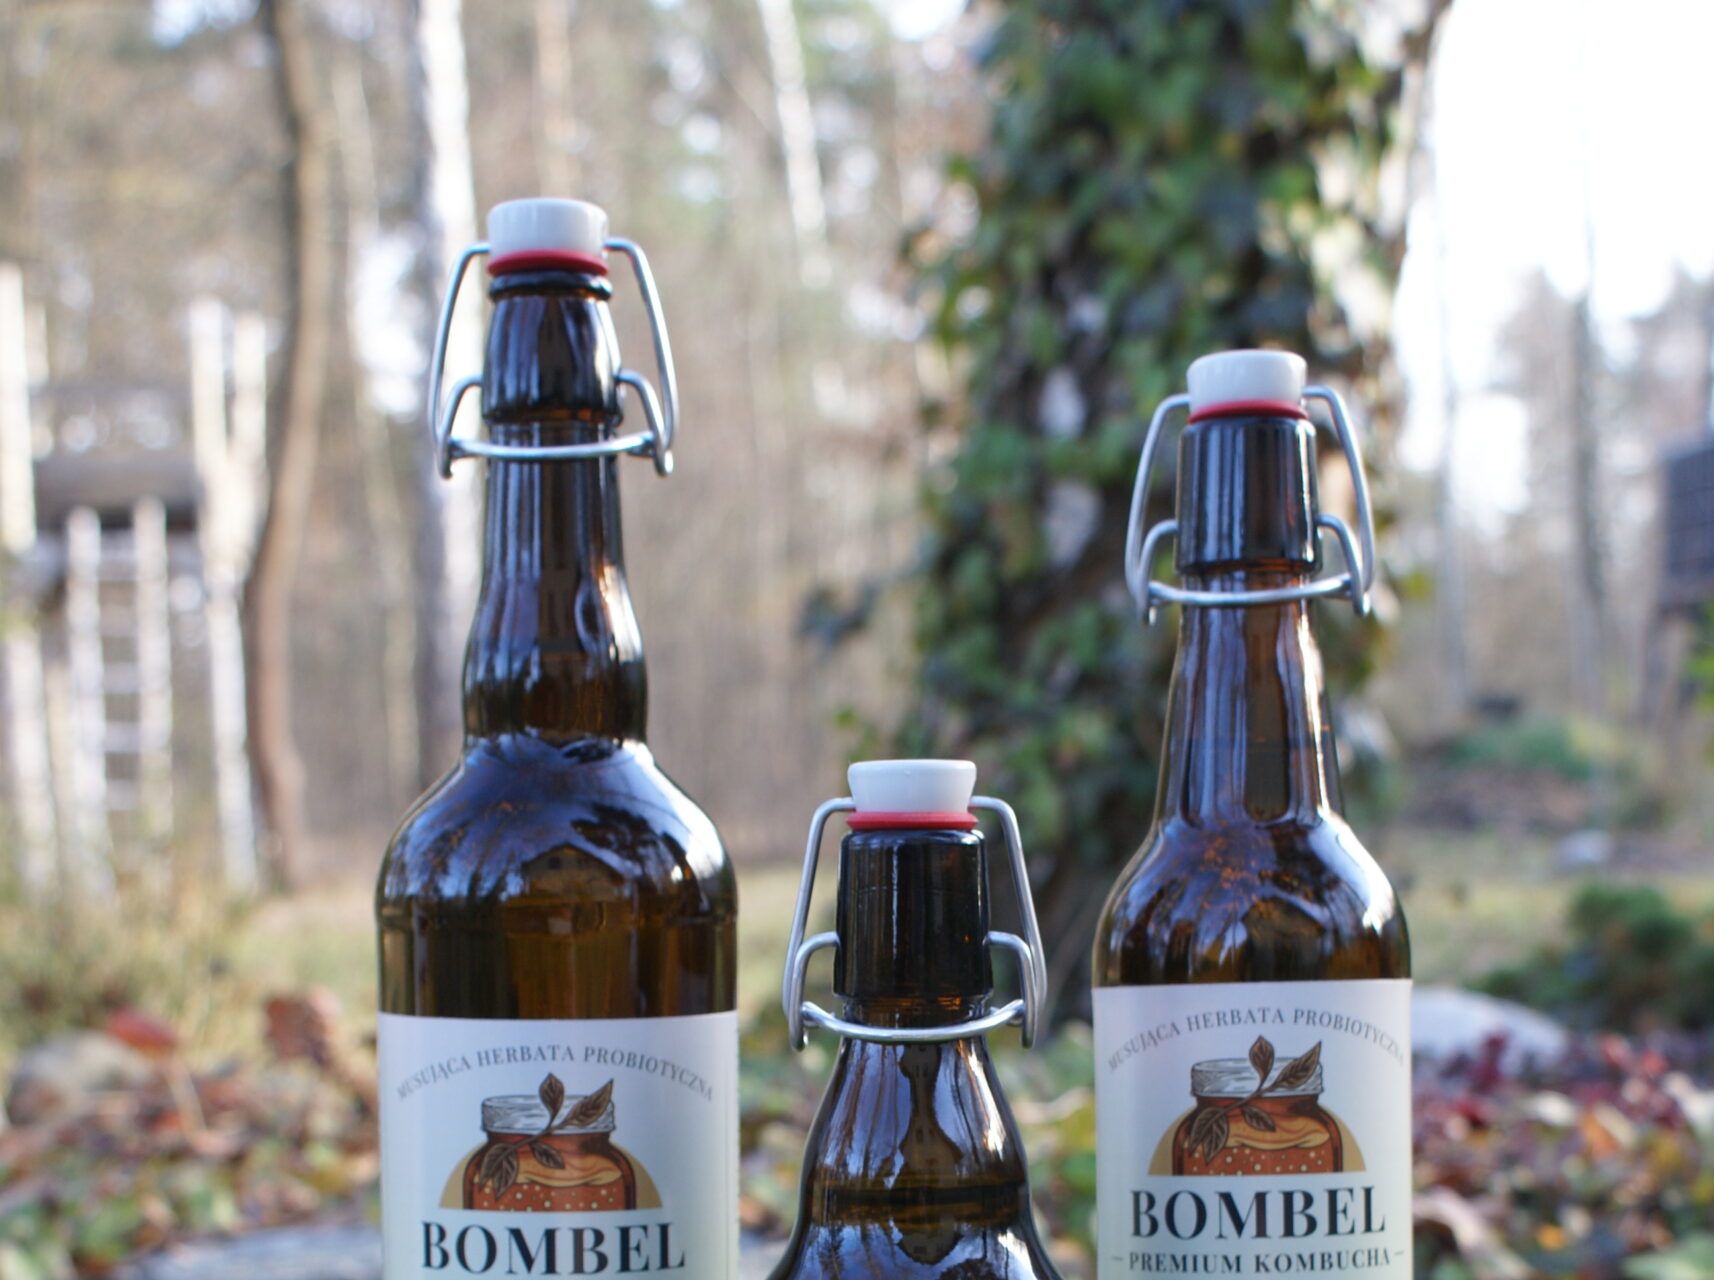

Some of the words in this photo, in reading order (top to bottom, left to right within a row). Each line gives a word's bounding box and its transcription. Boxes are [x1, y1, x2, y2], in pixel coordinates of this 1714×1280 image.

[1186, 1007, 1286, 1032] HERBATA
[477, 1044, 575, 1068] HERBATA
[584, 1046, 713, 1101] PROBIOTYCZNA
[1130, 1185, 1385, 1240] BOMBEL
[421, 1220, 685, 1276] BOMBEL
[1129, 1252, 1242, 1274] PREMIUM
[1254, 1247, 1391, 1274] KOMBUCHA
